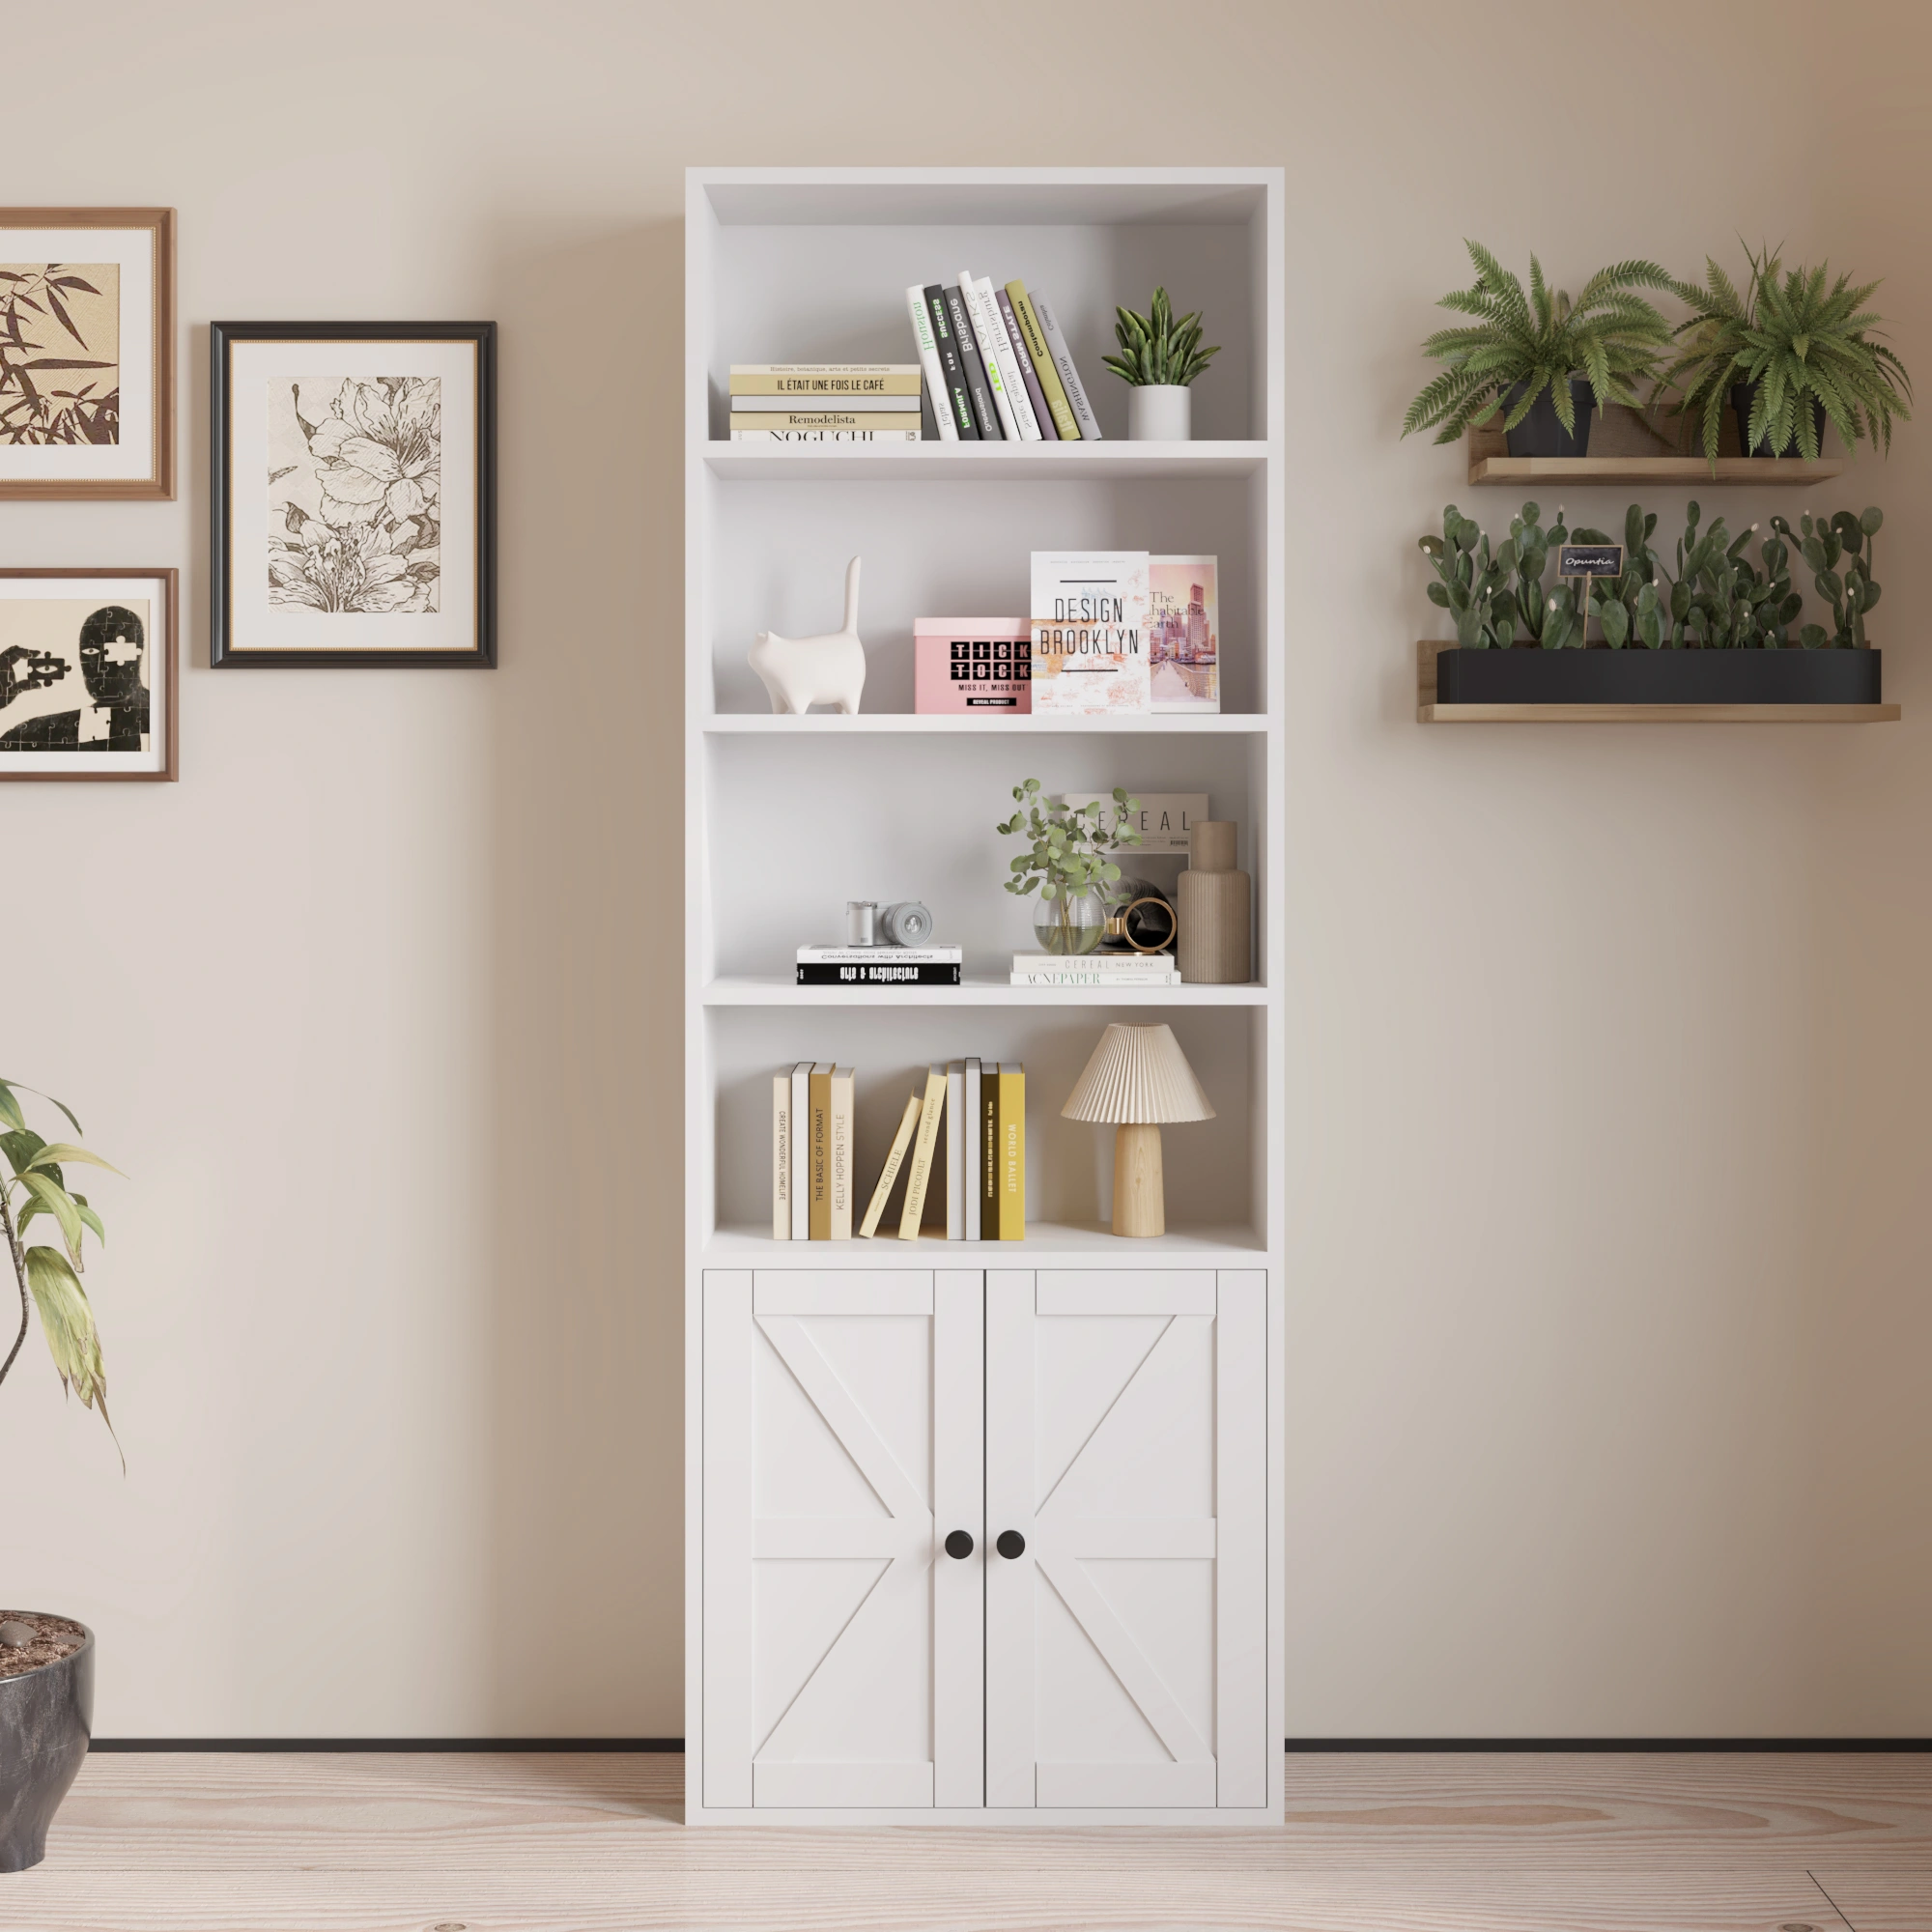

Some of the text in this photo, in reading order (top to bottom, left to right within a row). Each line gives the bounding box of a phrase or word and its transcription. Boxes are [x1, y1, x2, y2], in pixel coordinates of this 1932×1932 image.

[777, 378, 884, 390] IL ÉTAIT UNE FOIS LE CAFÉ
[789, 415, 855, 424] Remodelista
[1565, 557, 1614, 566] Opuntia
[1150, 592, 1174, 603] The
[1055, 598, 1123, 623] DESIGN
[1040, 630, 1139, 655] BROOKLYN
[955, 644, 1029, 658] TICK
[955, 664, 1029, 678] TOCK
[1065, 960, 1109, 969] CEREAL
[923, 1121, 931, 1144] second
[816, 1145, 824, 1157] OF
[836, 1114, 845, 1210] KELLY HOPPEN STYLE
[1008, 1124, 1016, 1193] WORLD BALLET
[882, 1149, 903, 1191] SCHIELE
[908, 1157, 926, 1216] JODI PICOULT
